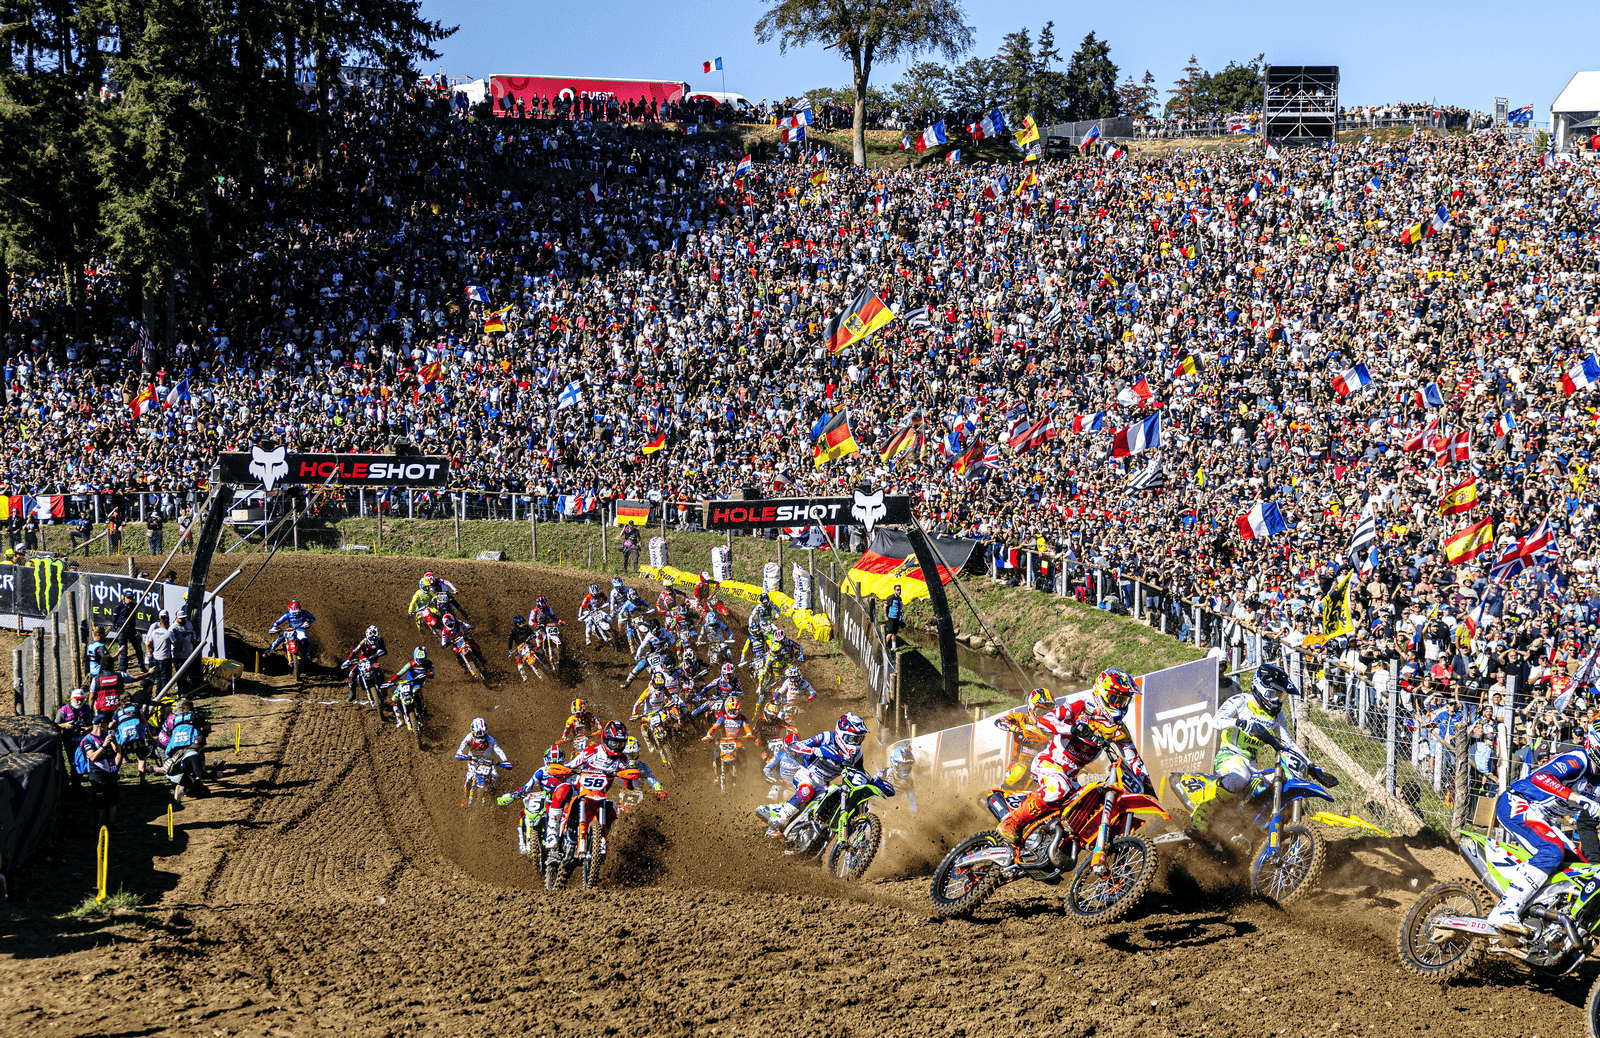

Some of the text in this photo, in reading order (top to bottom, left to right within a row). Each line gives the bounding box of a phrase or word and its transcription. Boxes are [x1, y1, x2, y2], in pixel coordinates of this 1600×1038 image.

[299, 461, 441, 481] HOLESHOT
[713, 504, 841, 524] HOLESHOT
[90, 581, 161, 611] ONTER
[92, 606, 152, 622] ENGY
[1151, 712, 1213, 757] MOTO
[1288, 756, 1308, 779] 34
[583, 777, 605, 788] 58
[1122, 770, 1142, 793] 28
[1181, 778, 1202, 794] 34
[527, 799, 541, 812] 5
